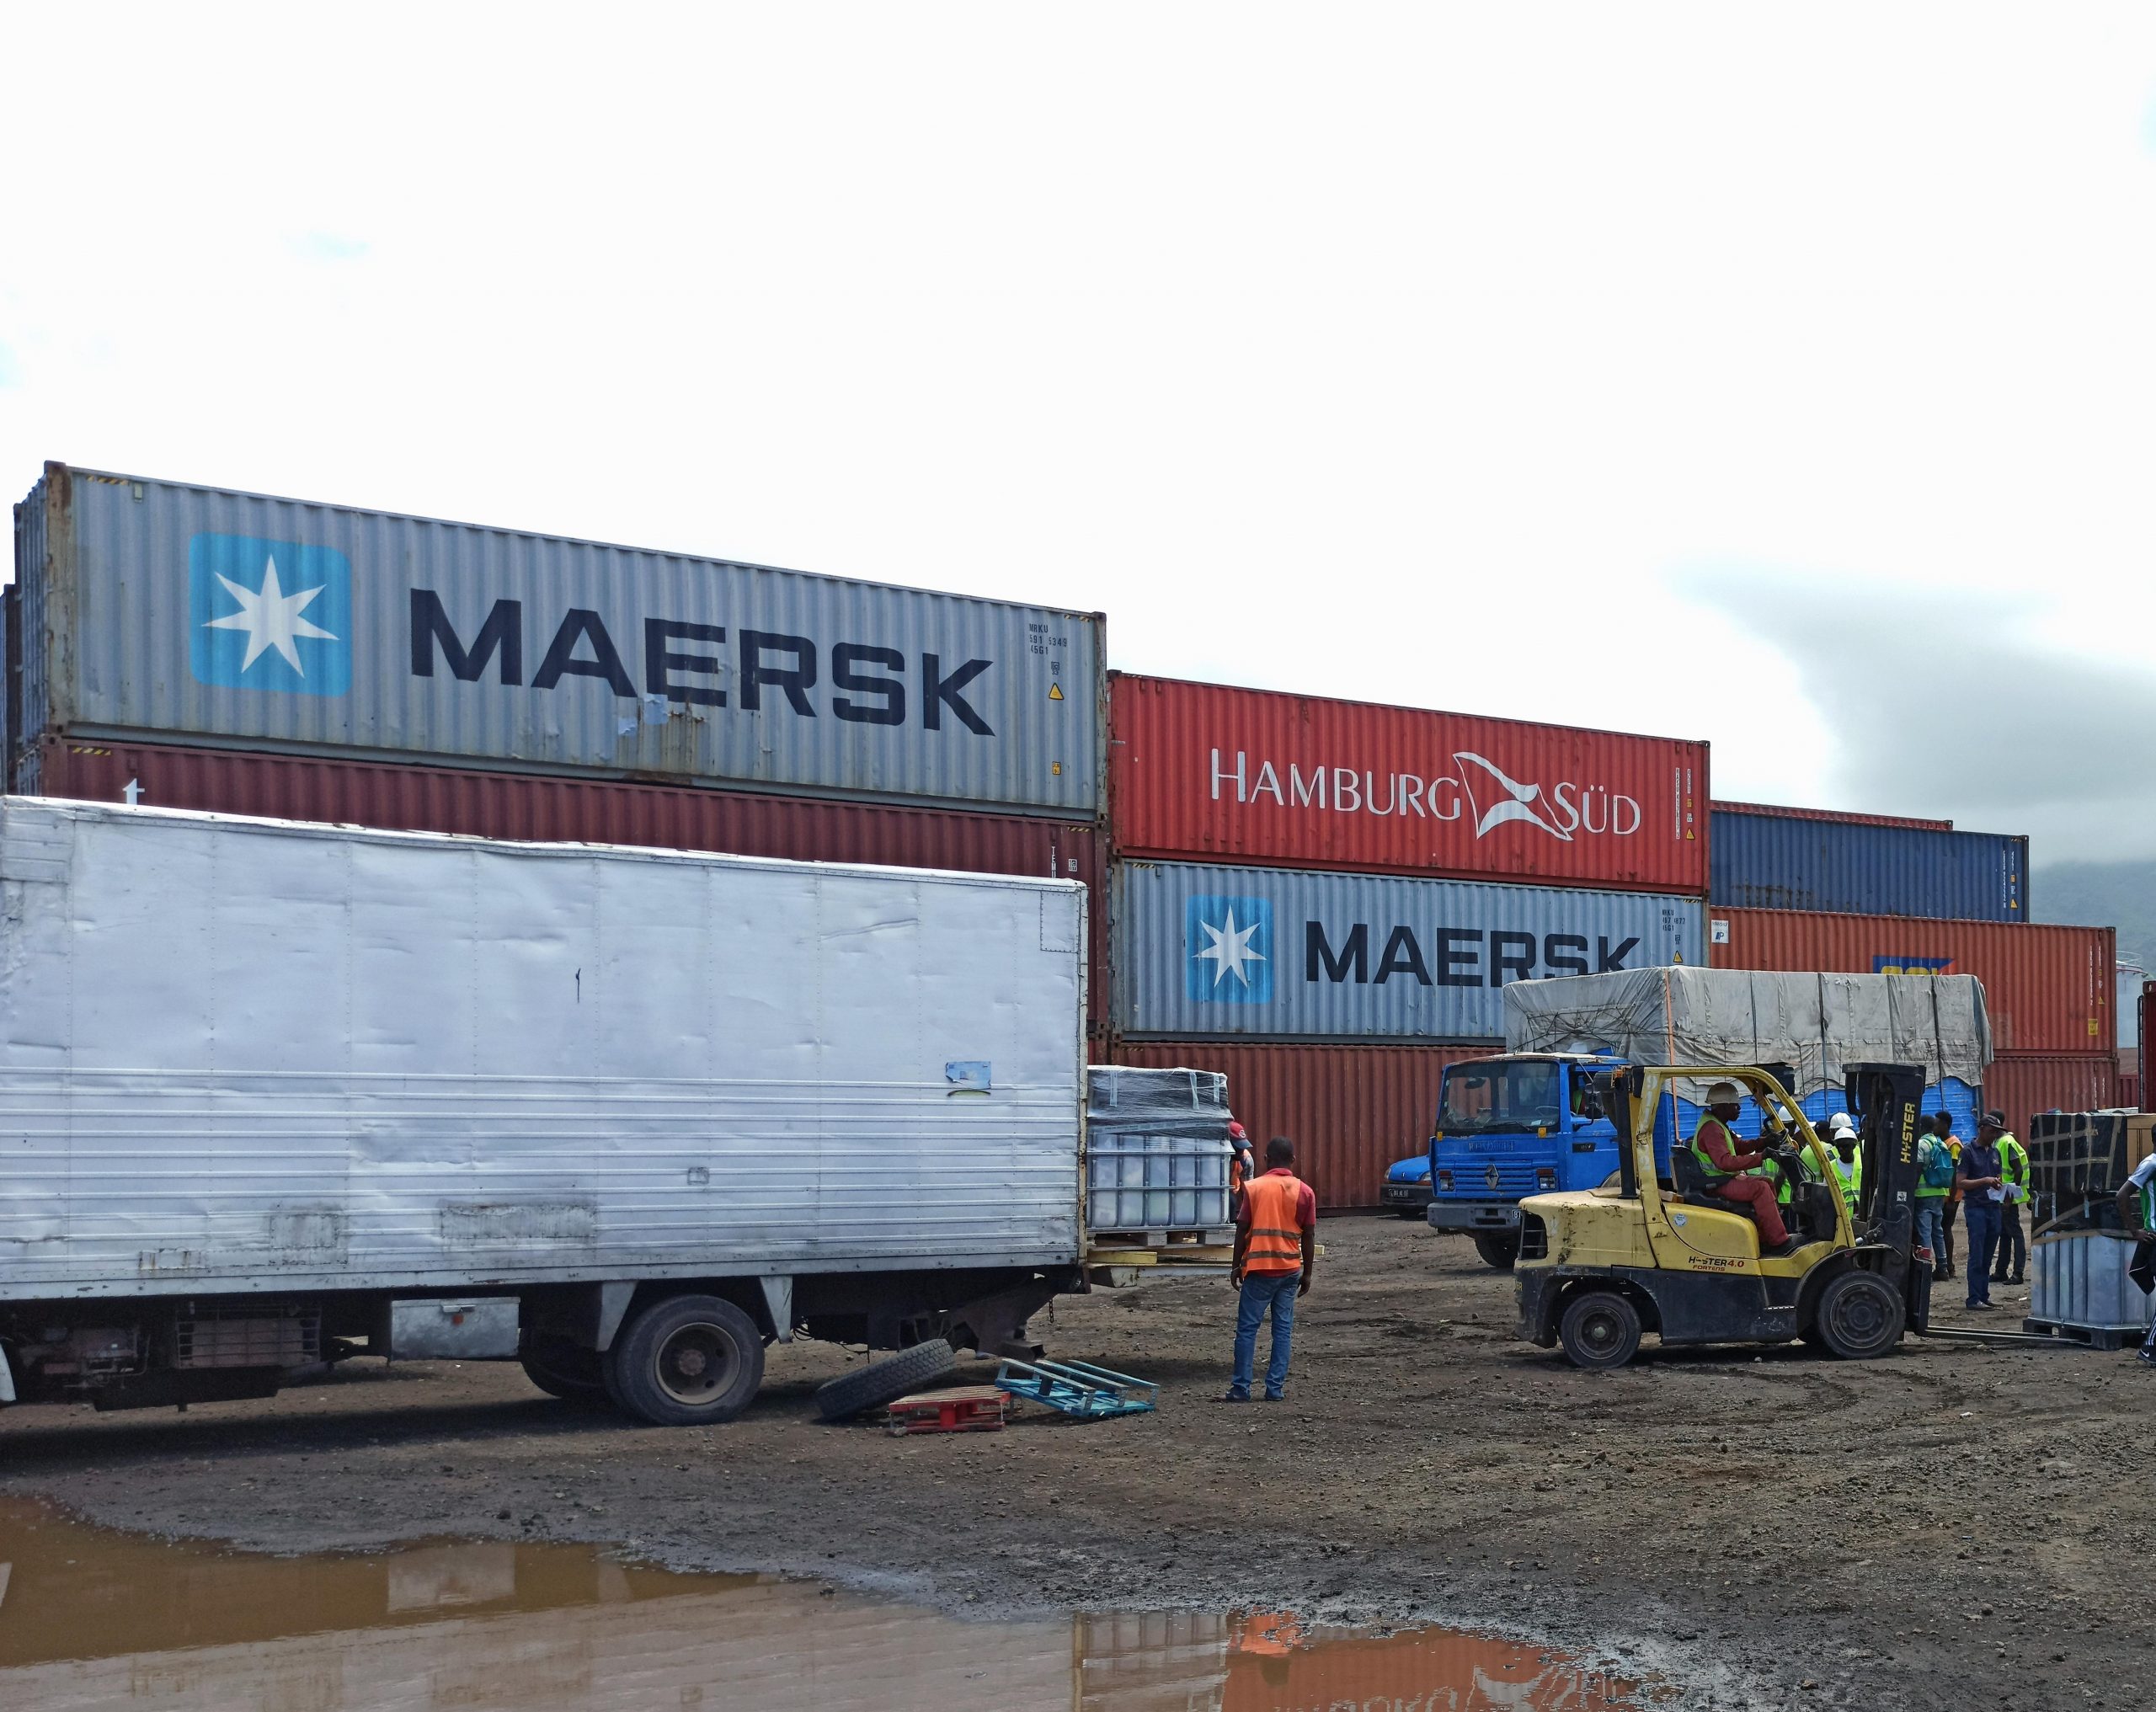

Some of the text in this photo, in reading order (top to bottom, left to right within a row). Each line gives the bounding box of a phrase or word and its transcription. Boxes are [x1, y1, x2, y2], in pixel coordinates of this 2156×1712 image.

[410, 588, 996, 737] MAERSK
[1211, 748, 1461, 821] HAMBURG
[1554, 781, 1641, 835] SÜD
[1306, 920, 1641, 988] MAERSK
[1900, 1101, 1916, 1164] HYSTER
